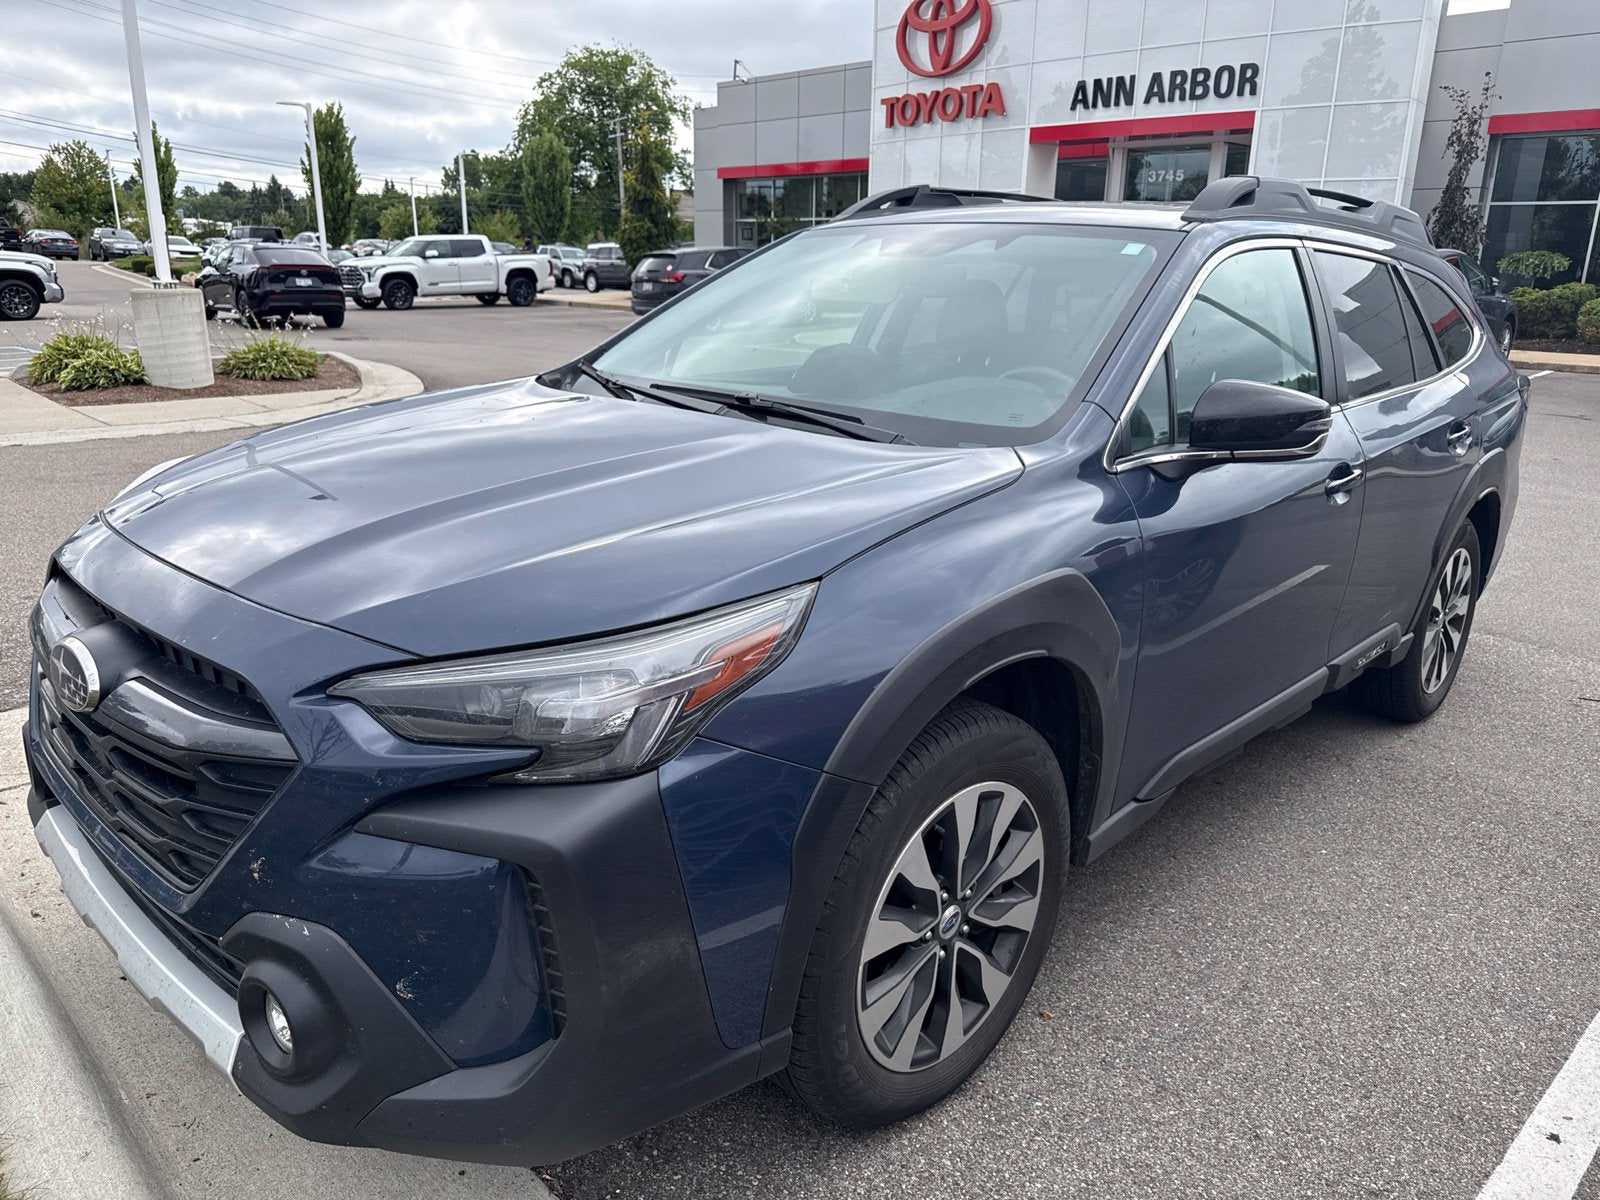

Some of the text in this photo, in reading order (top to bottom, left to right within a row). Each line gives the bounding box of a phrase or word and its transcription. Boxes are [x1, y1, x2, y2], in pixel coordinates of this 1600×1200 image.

[880, 82, 1006, 128] TOYOTA
[1070, 62, 1260, 111] ANN ARBOR
[1148, 169, 1184, 182] 3745
